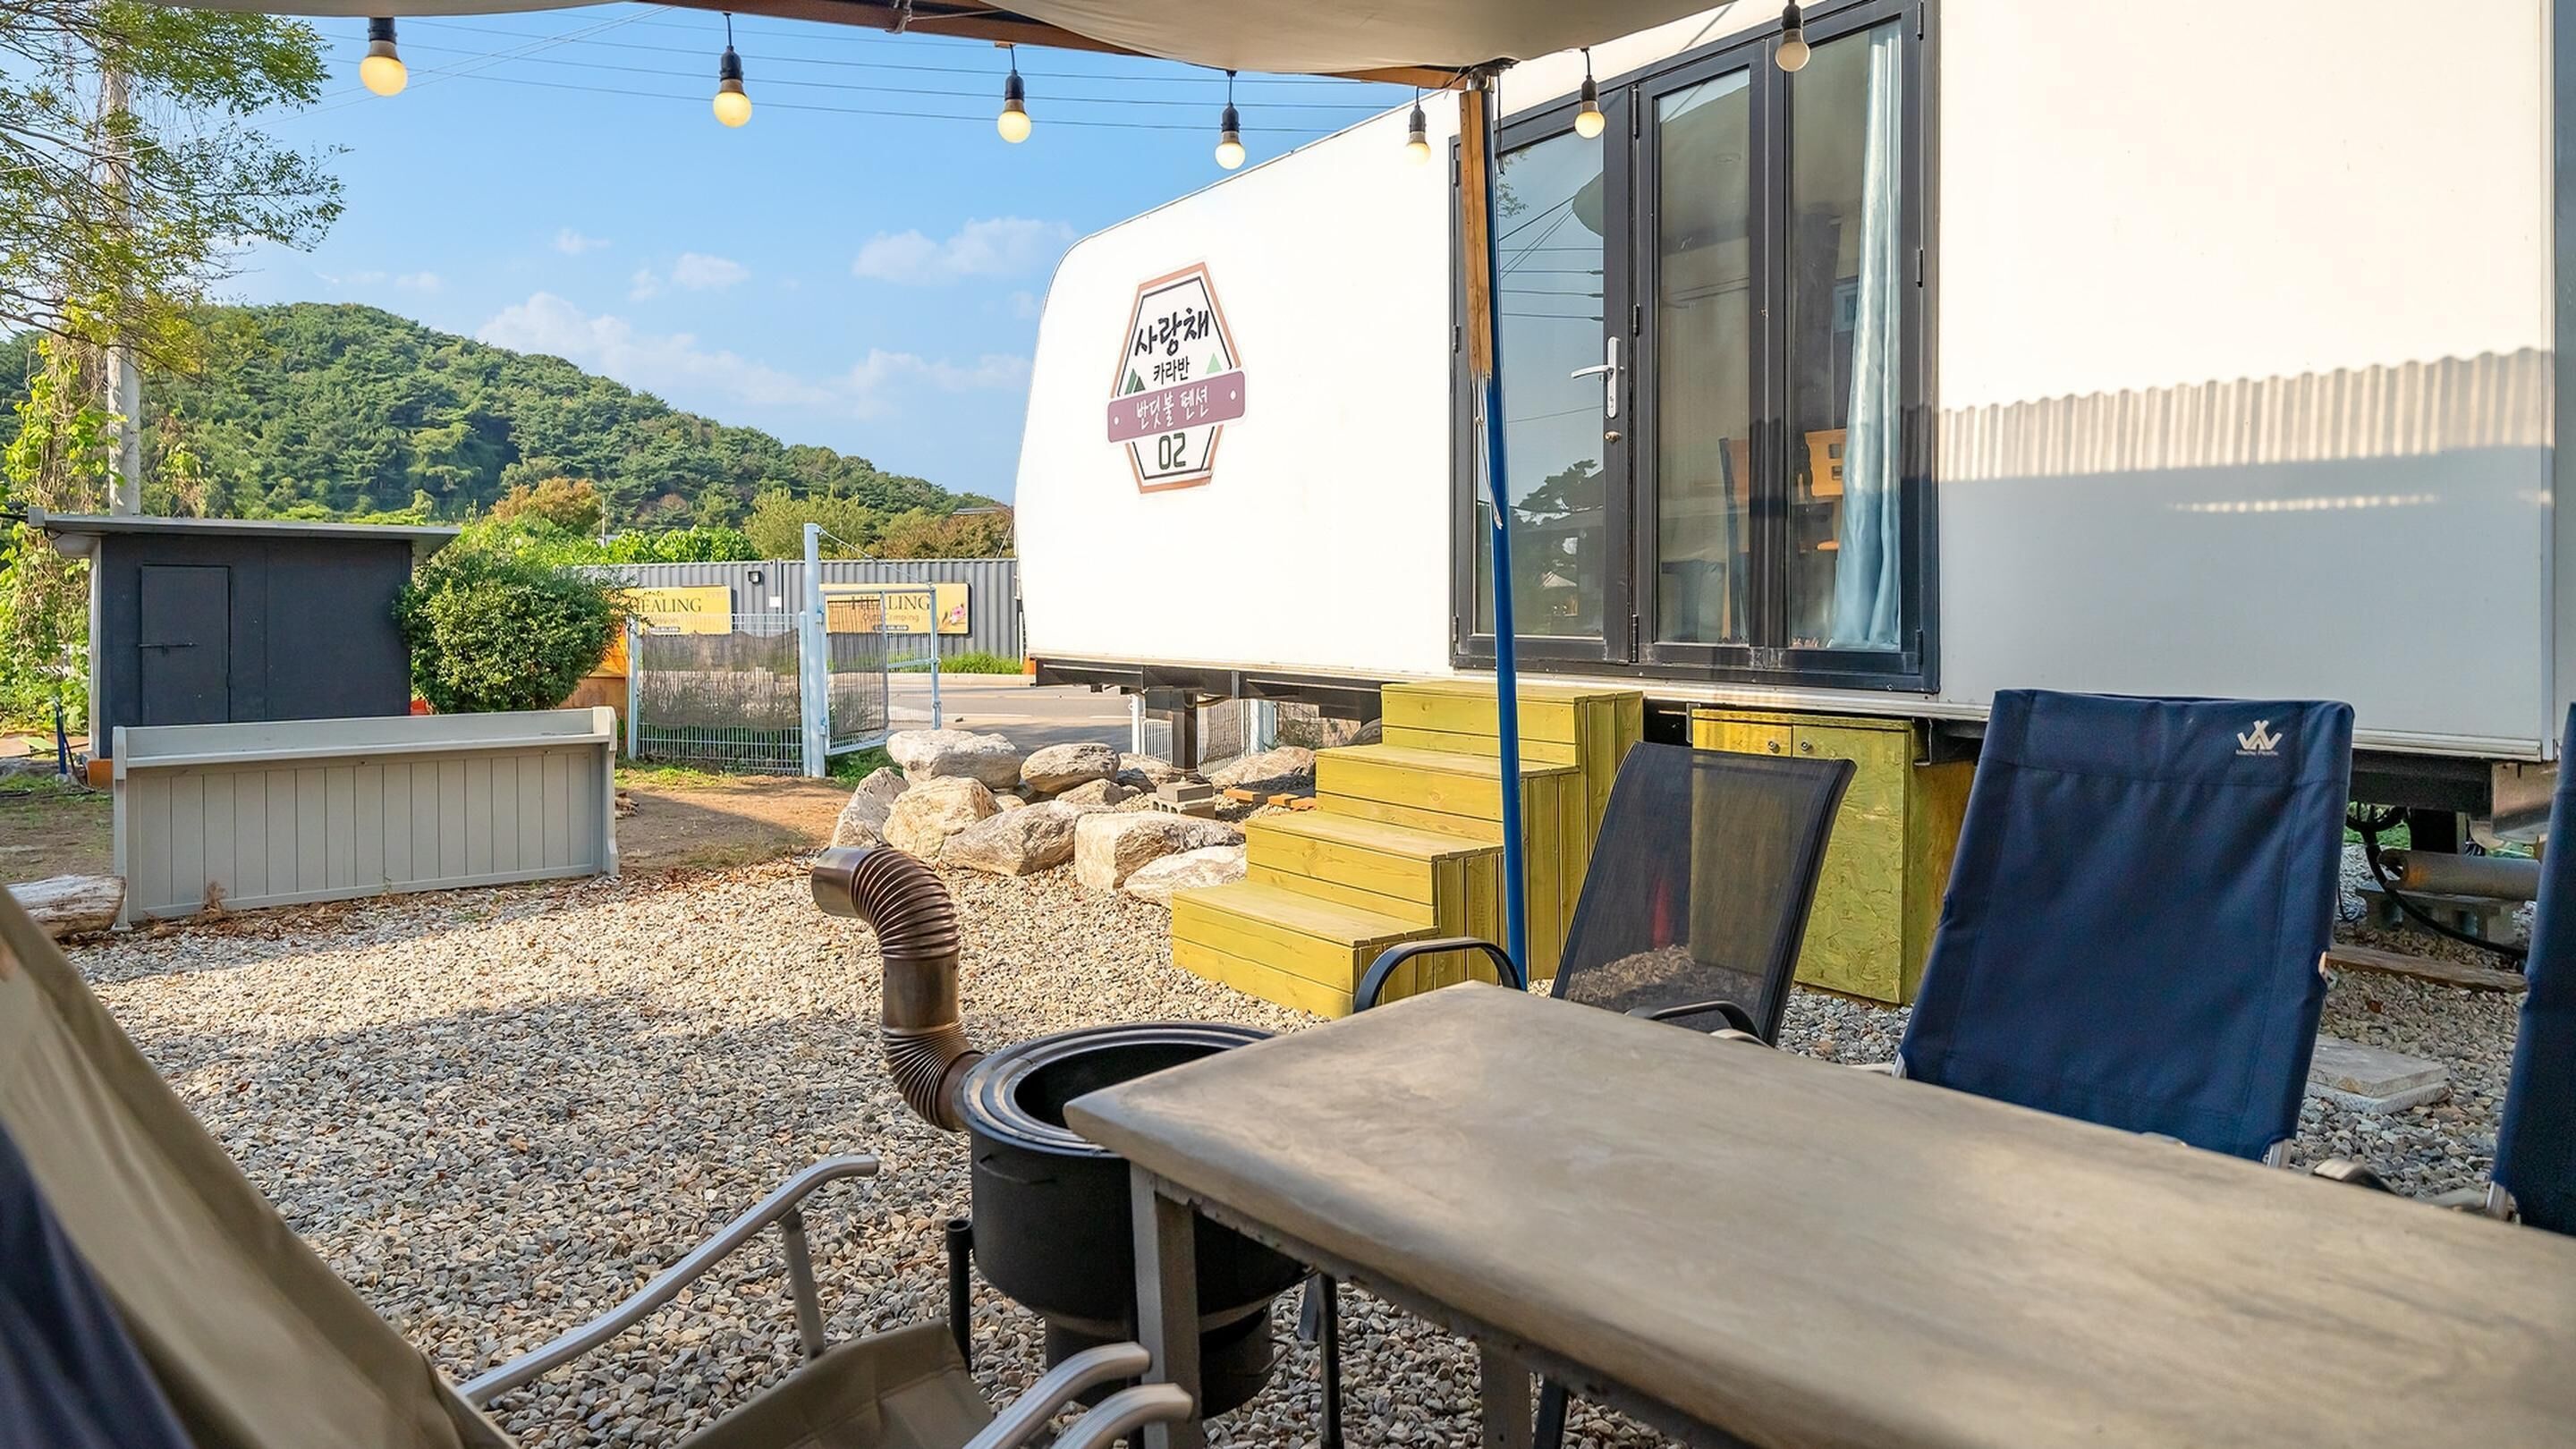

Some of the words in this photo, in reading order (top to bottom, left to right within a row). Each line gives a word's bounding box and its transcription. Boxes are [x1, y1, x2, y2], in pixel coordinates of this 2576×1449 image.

[1134, 308, 1209, 357] 사랑채
[1153, 356, 1191, 386] 카라반
[1136, 391, 1174, 430] 반딧불
[1180, 386, 1209, 421] 펜션
[1158, 432, 1187, 470] 02
[852, 595, 930, 611] HELING
